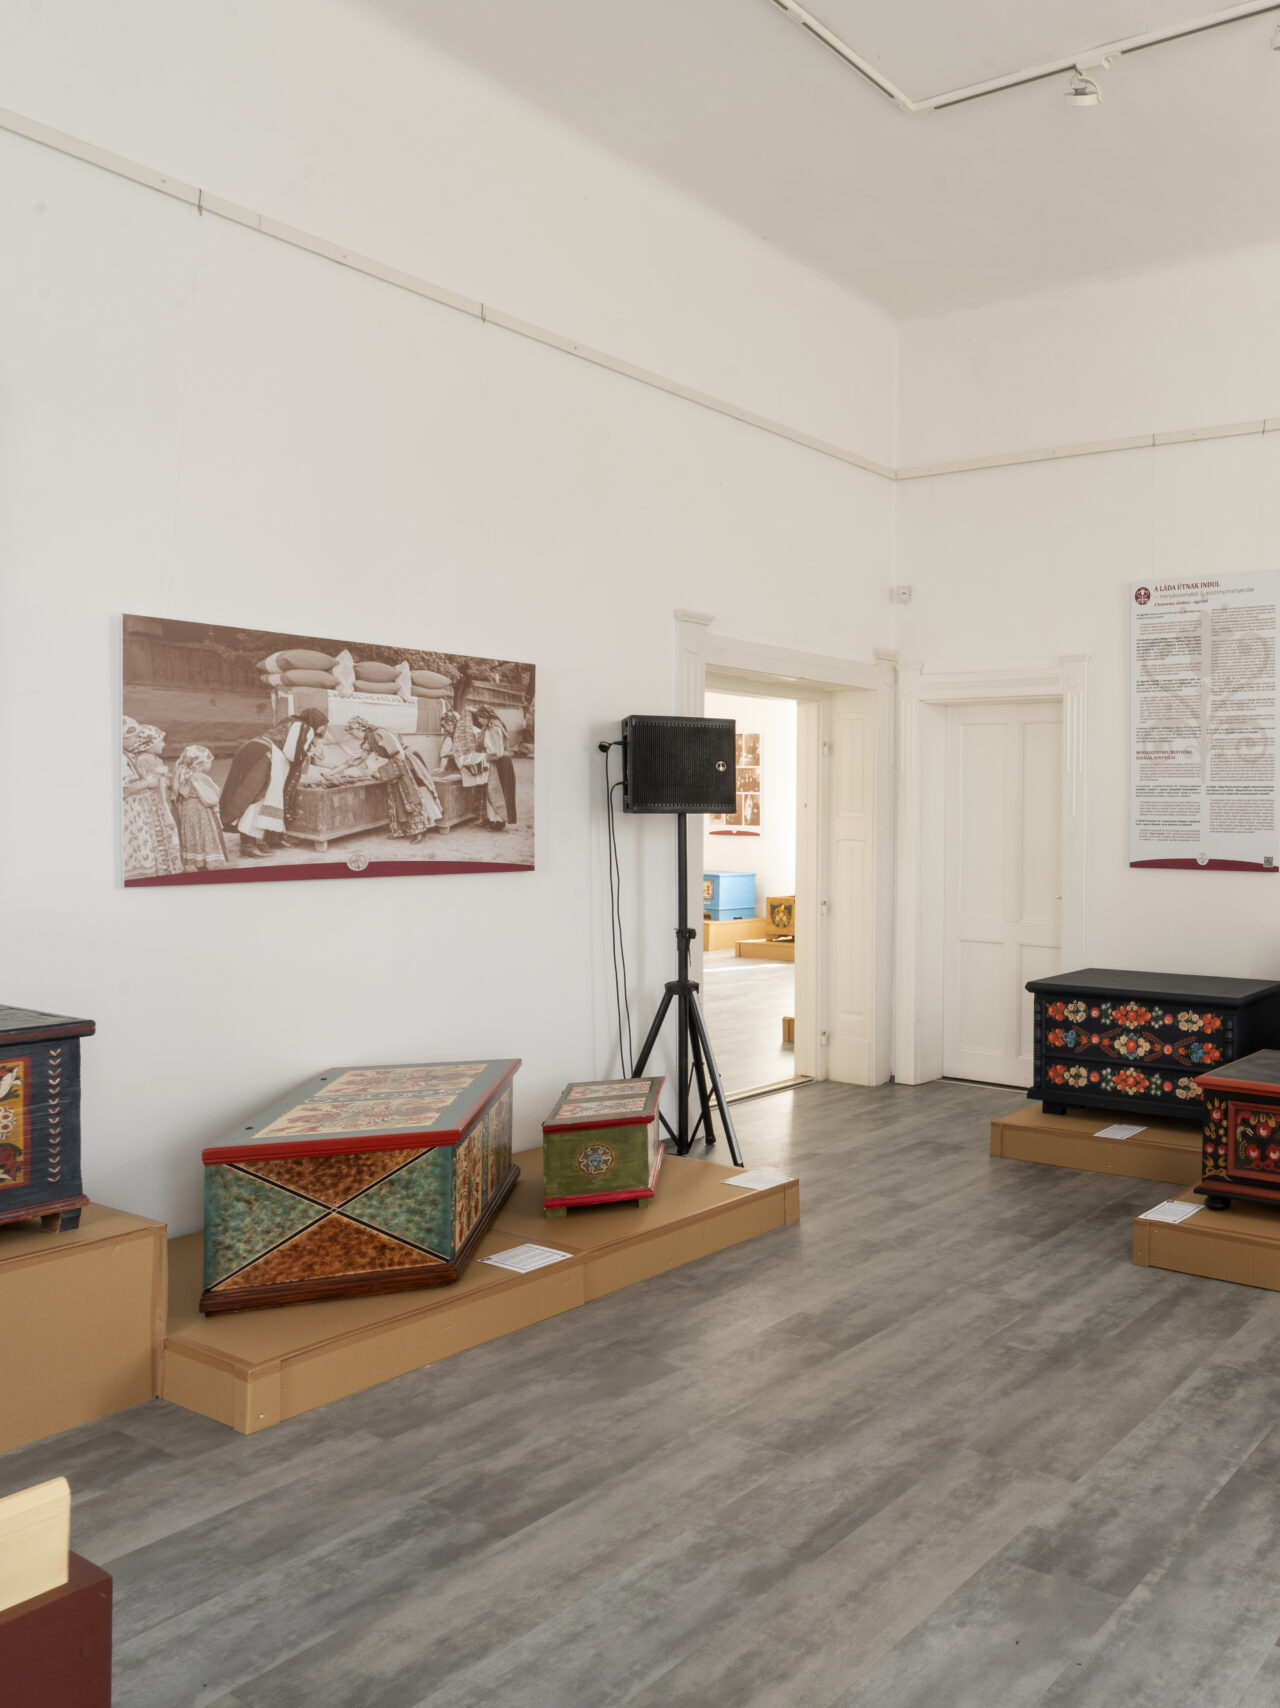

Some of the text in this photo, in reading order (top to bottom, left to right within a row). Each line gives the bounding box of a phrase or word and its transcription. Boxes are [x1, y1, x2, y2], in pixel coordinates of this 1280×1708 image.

[1159, 583, 1176, 592] LÁDA
[1177, 581, 1200, 590] ÚTNAK
[1200, 580, 1220, 588] INDUL
